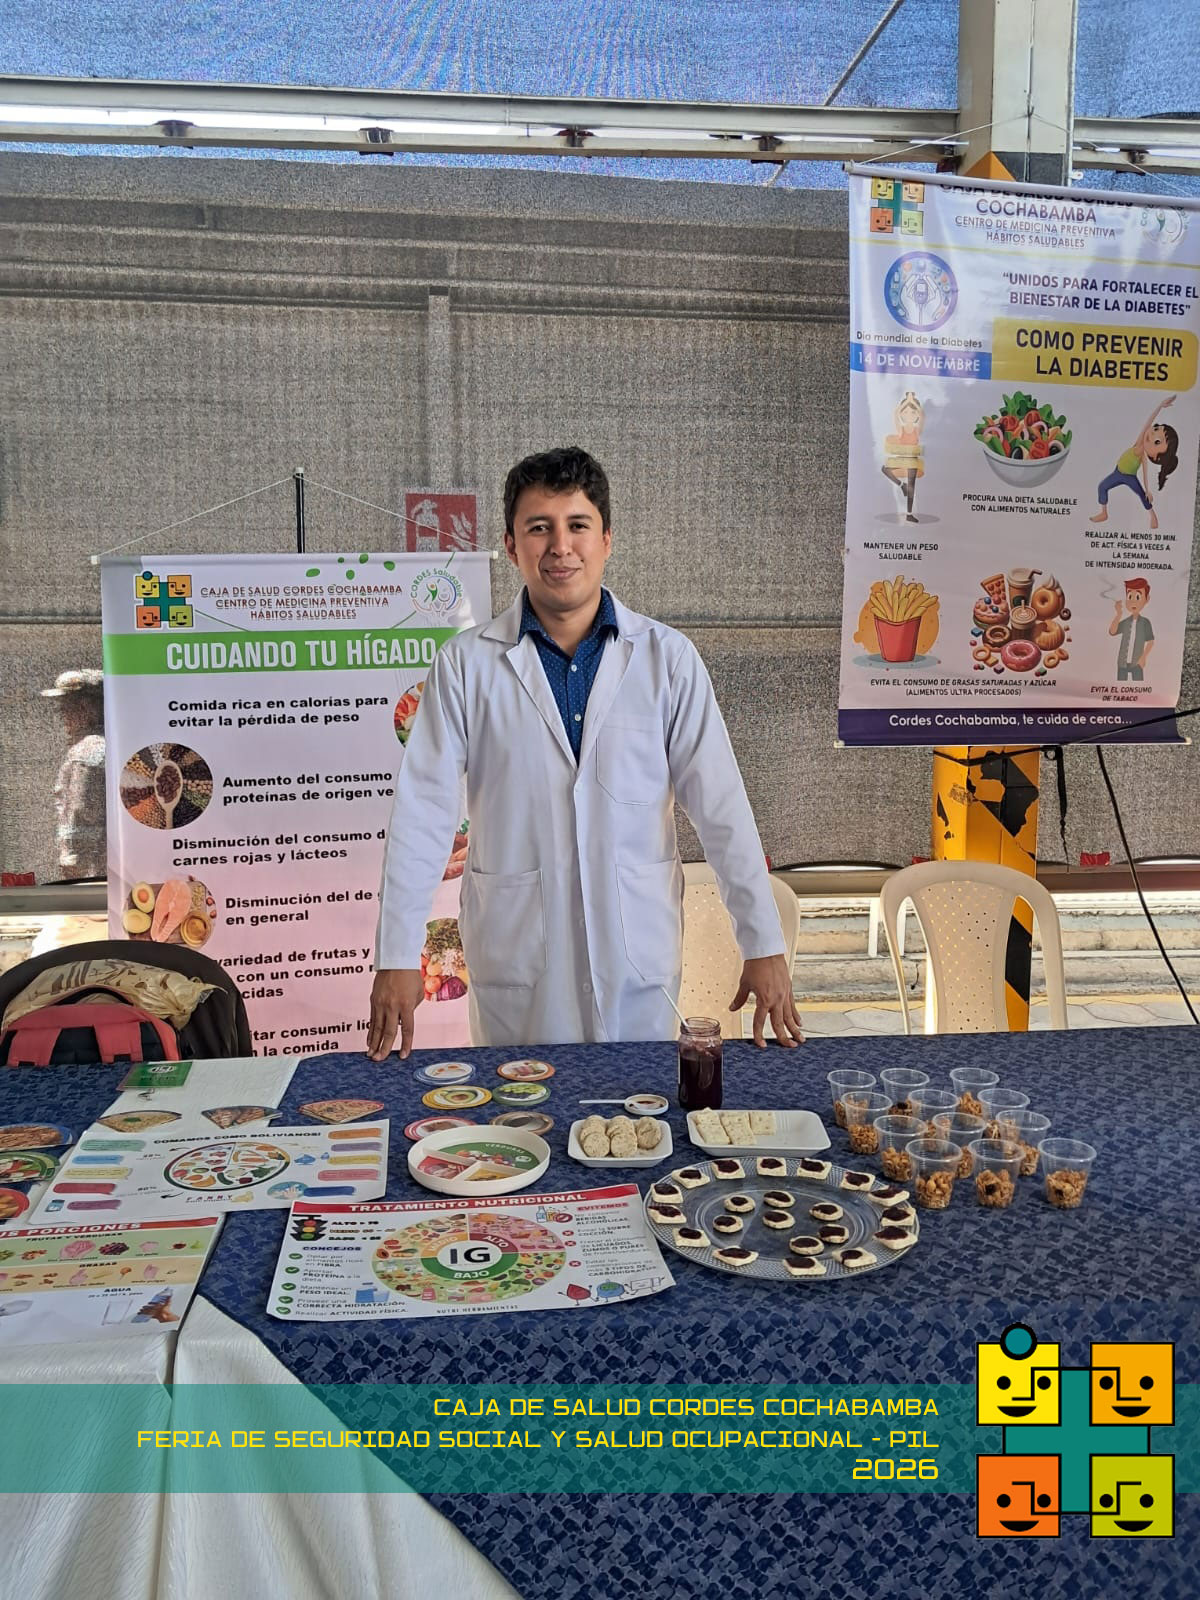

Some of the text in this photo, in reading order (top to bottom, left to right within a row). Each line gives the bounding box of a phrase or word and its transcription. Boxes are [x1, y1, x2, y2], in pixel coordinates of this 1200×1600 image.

[976, 198, 1096, 223] COCHABAMBA
[955, 215, 1116, 238] CENTRO DE MEDICINA PREVENTIVA
[986, 230, 1085, 248] HÁBITOS SALUDABLES
[1063, 277, 1098, 291] PARA
[1102, 280, 1181, 298] FORTALECER
[1185, 286, 1199, 299] EL
[1010, 292, 1080, 309] BIENESTAR
[1084, 297, 1100, 310] DE
[1104, 299, 1121, 311] LA
[874, 333, 982, 349] mundial de la Diabetes
[1016, 328, 1183, 358] COMO PREVENIR
[858, 352, 981, 372] 14 DE NOVIEMBRE
[1036, 355, 1169, 382] LA DIABETES
[963, 493, 1078, 506] PROCURA UNA DIETA SALUDABLE
[971, 504, 1071, 516] CON ALIMENTOS NATURALES
[1085, 531, 1118, 540] REALIZAR
[1120, 532, 1129, 540] AL
[1130, 533, 1152, 541] MENOS
[864, 542, 939, 551] MANTENER UN PESO
[878, 552, 923, 561] SALUDABLE
[1122, 552, 1149, 560] SEMANA
[1096, 561, 1136, 569] INTENSIDAD
[200, 585, 402, 597] CAJA DE SALUD CORDES COCHABAMBA
[433, 568, 463, 598] Saludable
[216, 597, 389, 609] CENTRO DE MEDICINA PREVENTIVA
[250, 609, 357, 620] HÁBITOS SALUDABLES
[166, 633, 437, 671] CUIDANDO TU HÍGADO
[870, 678, 891, 687] EVITA
[903, 679, 939, 687] CONSUMO
[952, 679, 980, 687] GRASAS
[982, 679, 1022, 687] SATURADAS
[1023, 679, 1029, 687] Y
[1090, 686, 1152, 694] EVITA EL CONSUMO
[906, 688, 1022, 697] (ALIMENTOS ULTRA PROCESADOS)
[168, 699, 227, 711] Comida
[232, 698, 261, 710] rica
[267, 700, 285, 709] en
[356, 696, 389, 709] para
[168, 712, 360, 728] evitar la pérdida de peso
[889, 714, 932, 726] Cordes
[934, 714, 1021, 727] Cochabamba,
[1023, 714, 1035, 725] te
[1037, 713, 1071, 725] cuida
[1072, 713, 1087, 725] de
[222, 772, 393, 788] Aumento del consumo
[302, 789, 320, 801] de
[325, 788, 373, 802] origen
[173, 832, 372, 850] Disminución del consumo
[173, 848, 348, 867] carnes rojas y lácteos
[225, 889, 373, 909] Disminución del de
[226, 910, 309, 927] en general
[288, 951, 306, 962] de
[311, 948, 357, 961] frutas
[362, 948, 371, 960] y
[236, 972, 265, 983] con
[270, 970, 289, 981] un
[294, 965, 364, 978] consumo
[242, 986, 284, 1000] cidas
[281, 1022, 353, 1039] consumir
[264, 1040, 339, 1057] la comida
[350, 1193, 587, 1212] TRATAMIENTO NUTRICIONAL
[27, 1222, 142, 1236] PORCIONES
[483, 1235, 509, 1248] ALTO
[450, 1247, 491, 1265] IG
[453, 1270, 490, 1279] BAJO
